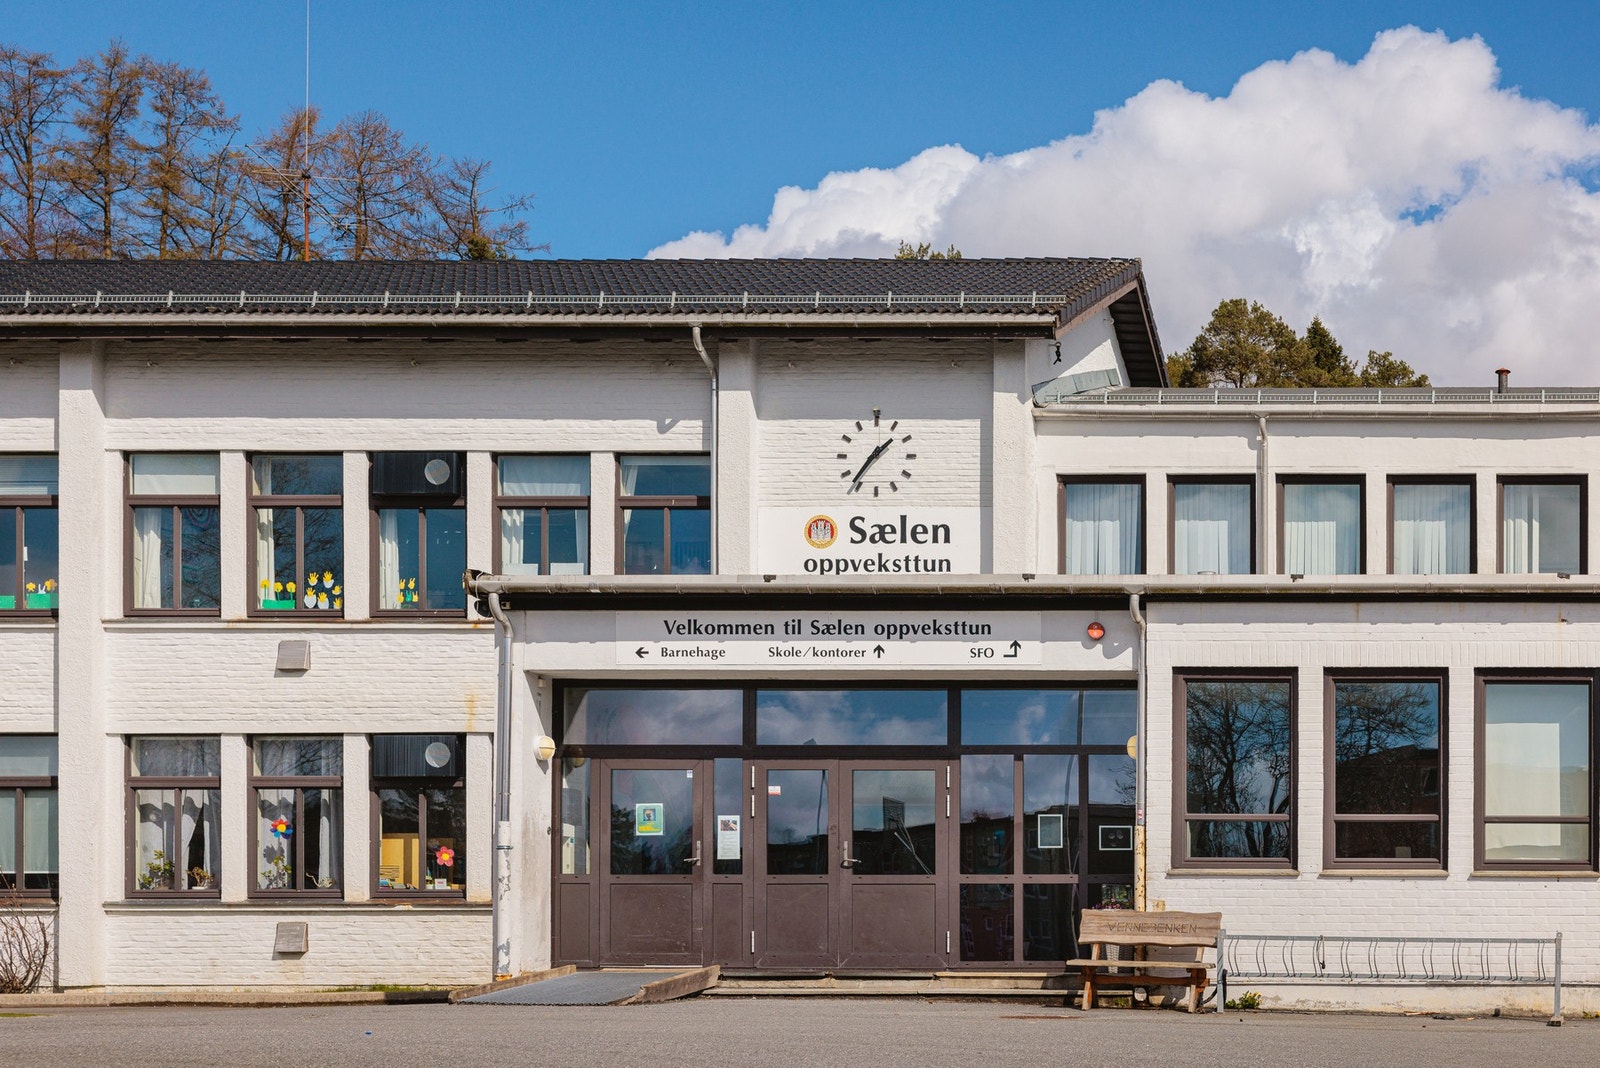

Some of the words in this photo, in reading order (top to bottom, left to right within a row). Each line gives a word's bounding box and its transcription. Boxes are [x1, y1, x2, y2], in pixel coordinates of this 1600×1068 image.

[849, 514, 951, 545] Sælen
[803, 552, 951, 575] oppveksttun
[663, 619, 775, 636] Velkommen
[783, 618, 802, 636] til
[810, 618, 865, 636] Sælen
[873, 618, 992, 640] oppveksttun
[660, 646, 726, 661] Barnehage
[768, 646, 867, 659] Skole/kontorer
[969, 647, 995, 659] SFO
